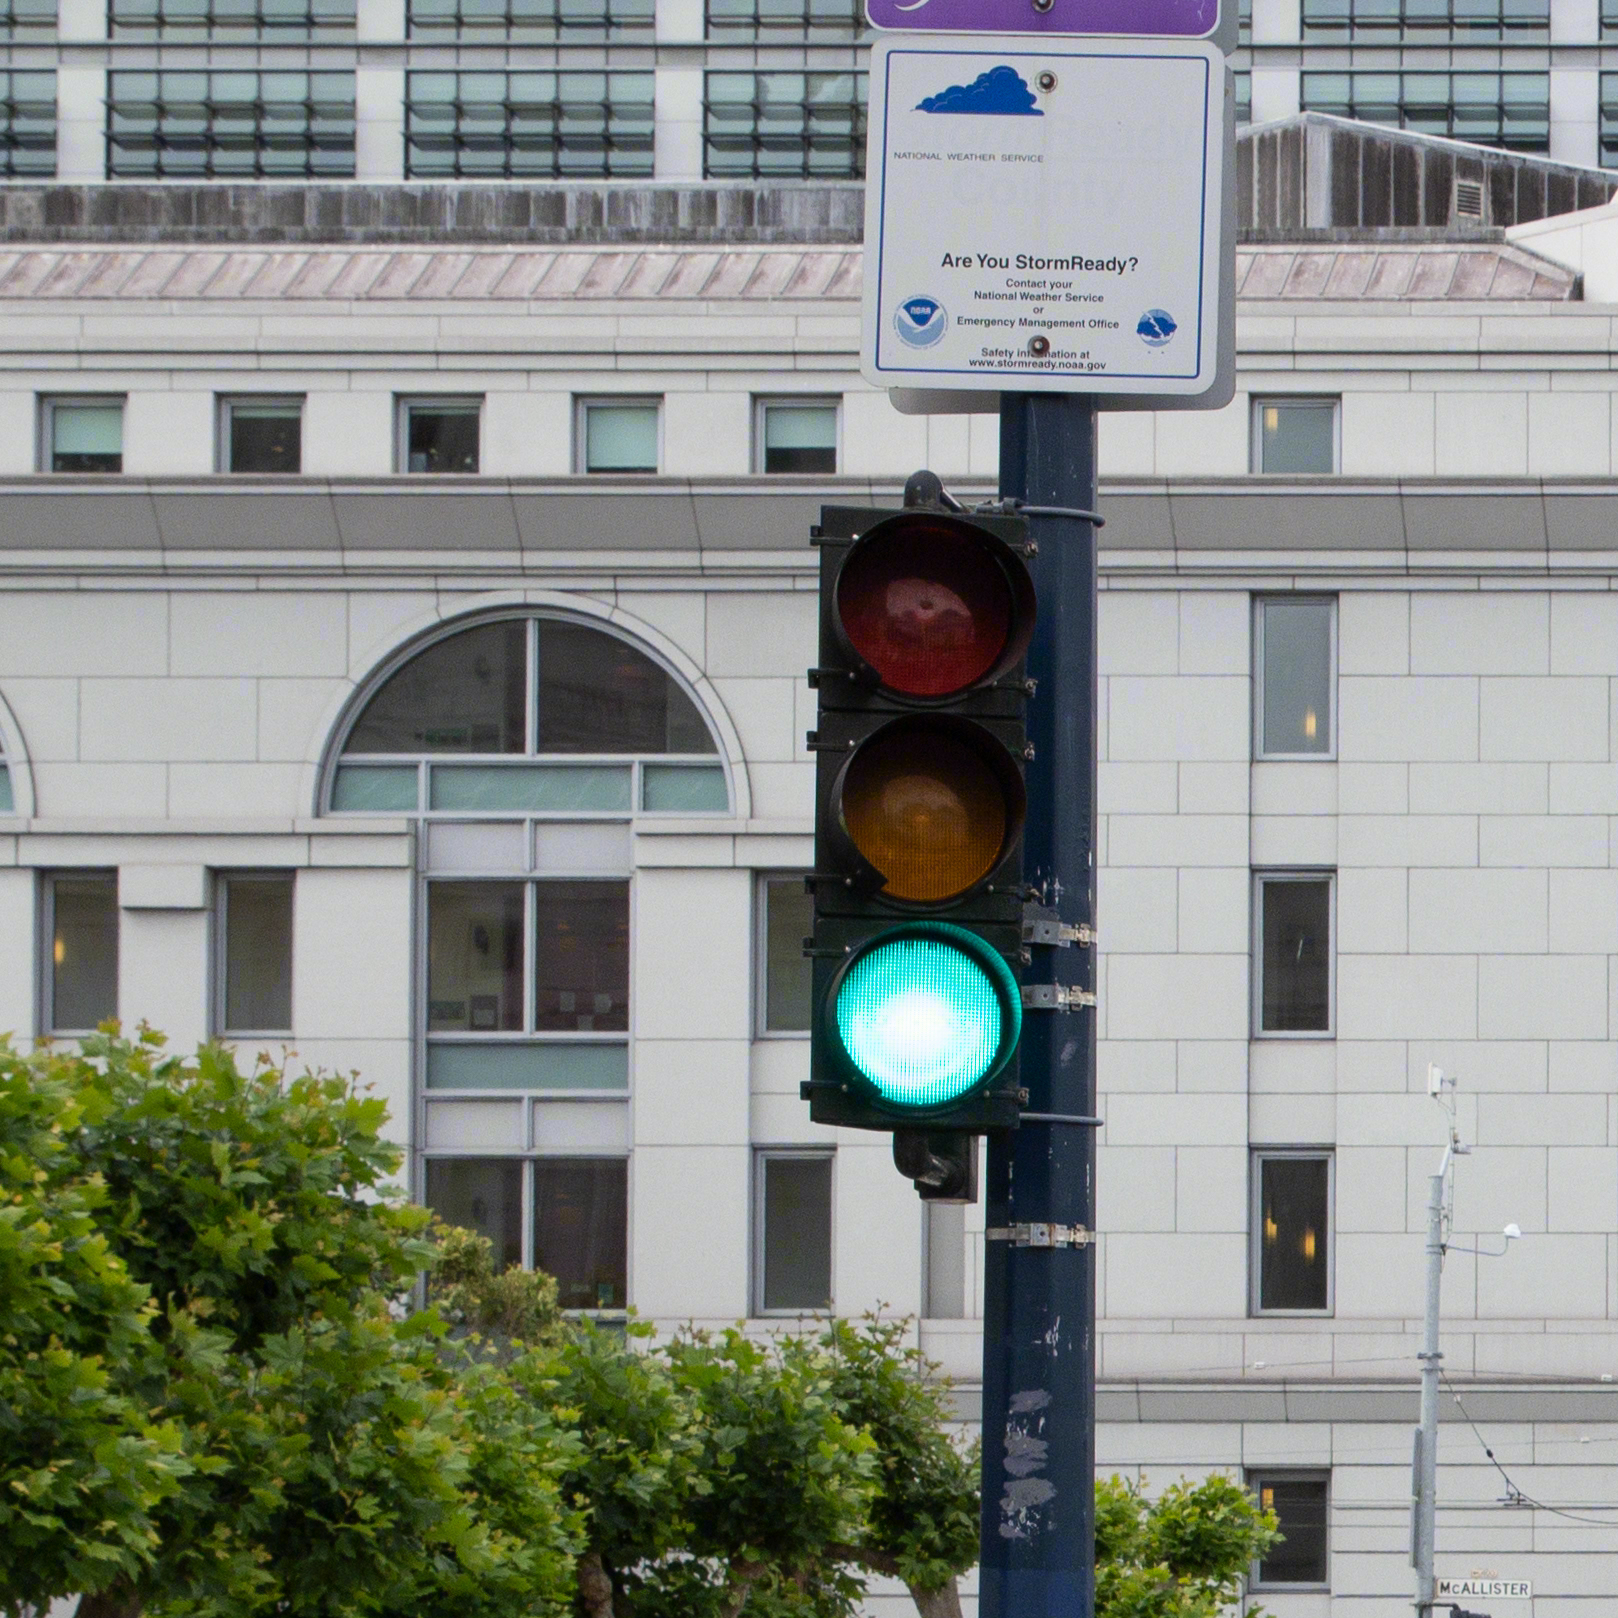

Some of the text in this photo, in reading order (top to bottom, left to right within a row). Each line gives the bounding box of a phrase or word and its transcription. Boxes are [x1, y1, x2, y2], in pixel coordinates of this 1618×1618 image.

[893, 151, 1044, 163] NATIONAL WEATHER SERVICE
[941, 253, 1139, 276] Are You StormReady?
[1005, 278, 1073, 291] Contact your
[974, 290, 1105, 302] National Weather Service
[1033, 306, 1045, 315] or
[957, 316, 1119, 330] Emergency Management Office
[981, 348, 1014, 360] Safety
[1080, 351, 1090, 360] at
[969, 359, 1107, 371] www.stormready.noaa.gov
